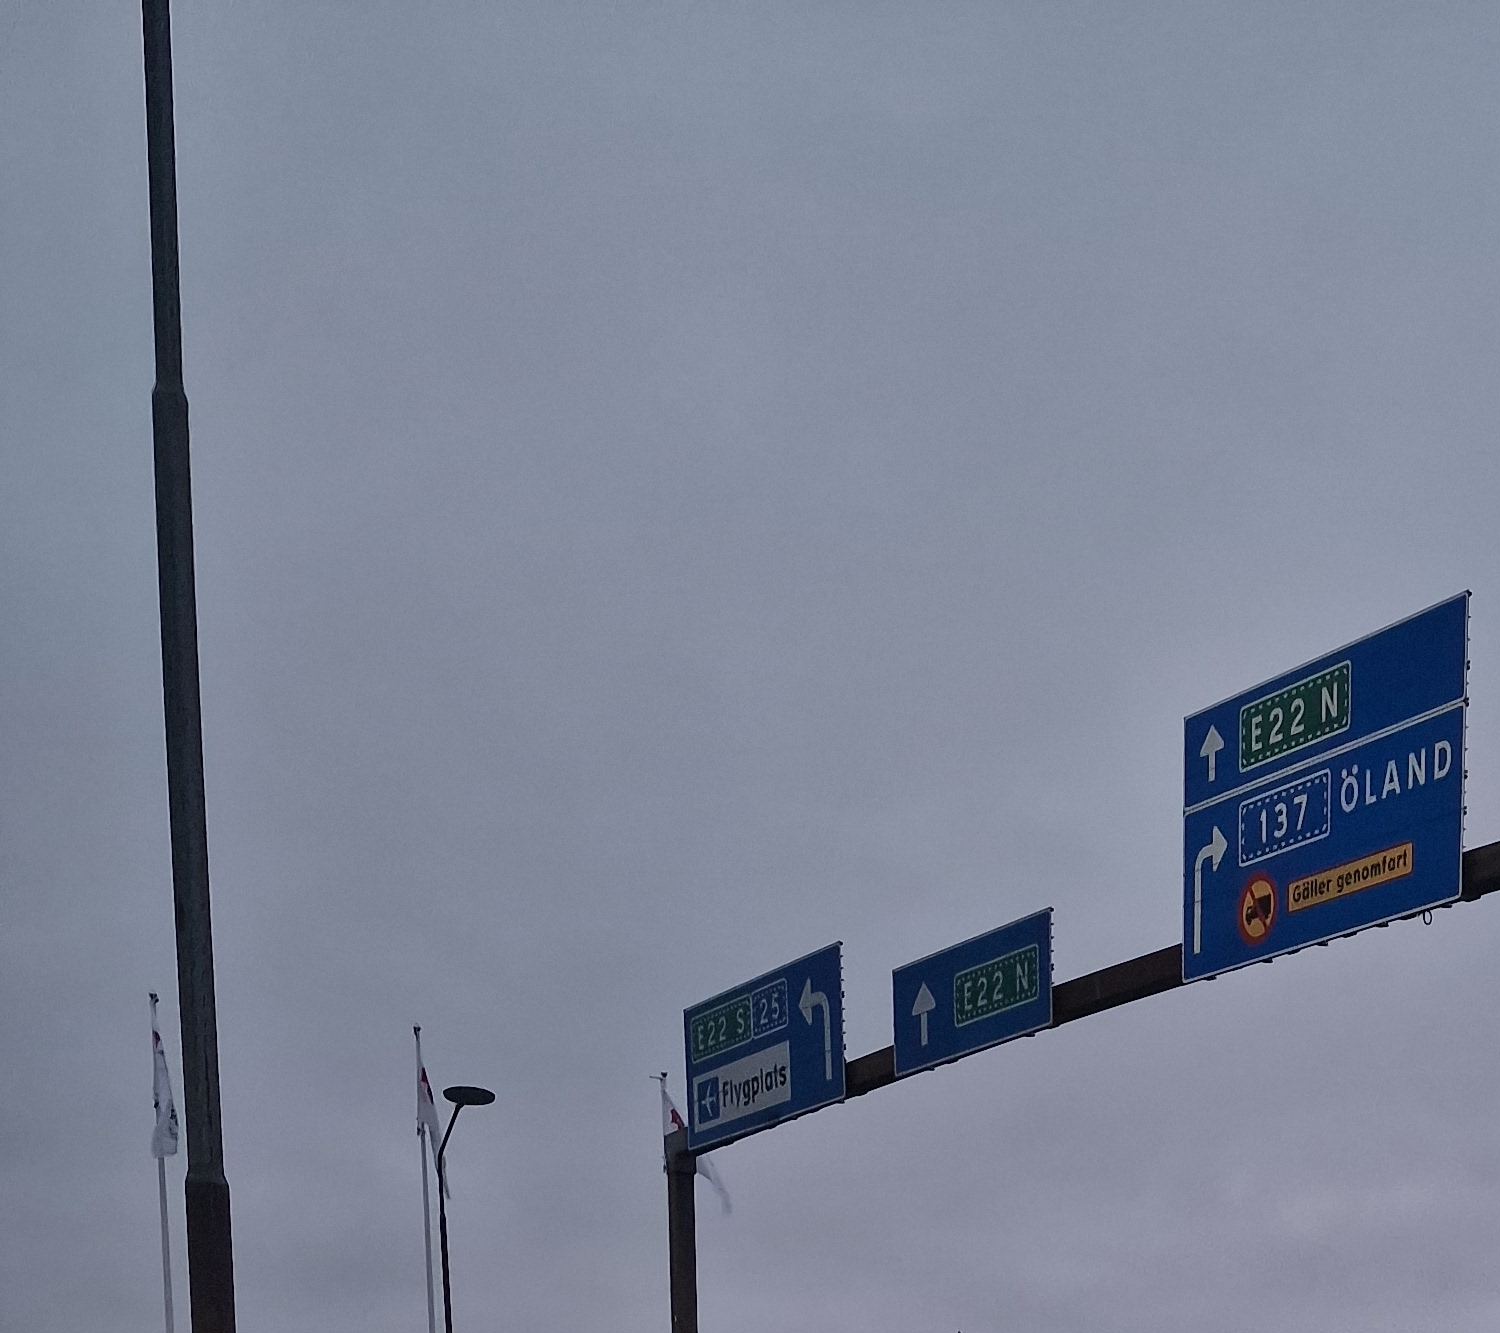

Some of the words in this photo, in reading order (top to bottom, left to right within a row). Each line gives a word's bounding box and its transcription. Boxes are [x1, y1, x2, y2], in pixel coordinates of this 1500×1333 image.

[1252, 701, 1304, 752] E22
[1321, 682, 1338, 722] N
[1260, 794, 1308, 843] 137
[1340, 740, 1452, 813] ÖLAND
[1293, 875, 1332, 903] Gäller
[1337, 849, 1408, 889] genomfart
[965, 971, 1003, 1011] E22
[1016, 963, 1029, 991] N
[697, 1017, 726, 1051] E22
[737, 1007, 745, 1034] S
[759, 992, 780, 1024] 25
[722, 1064, 787, 1108] Flygplats
